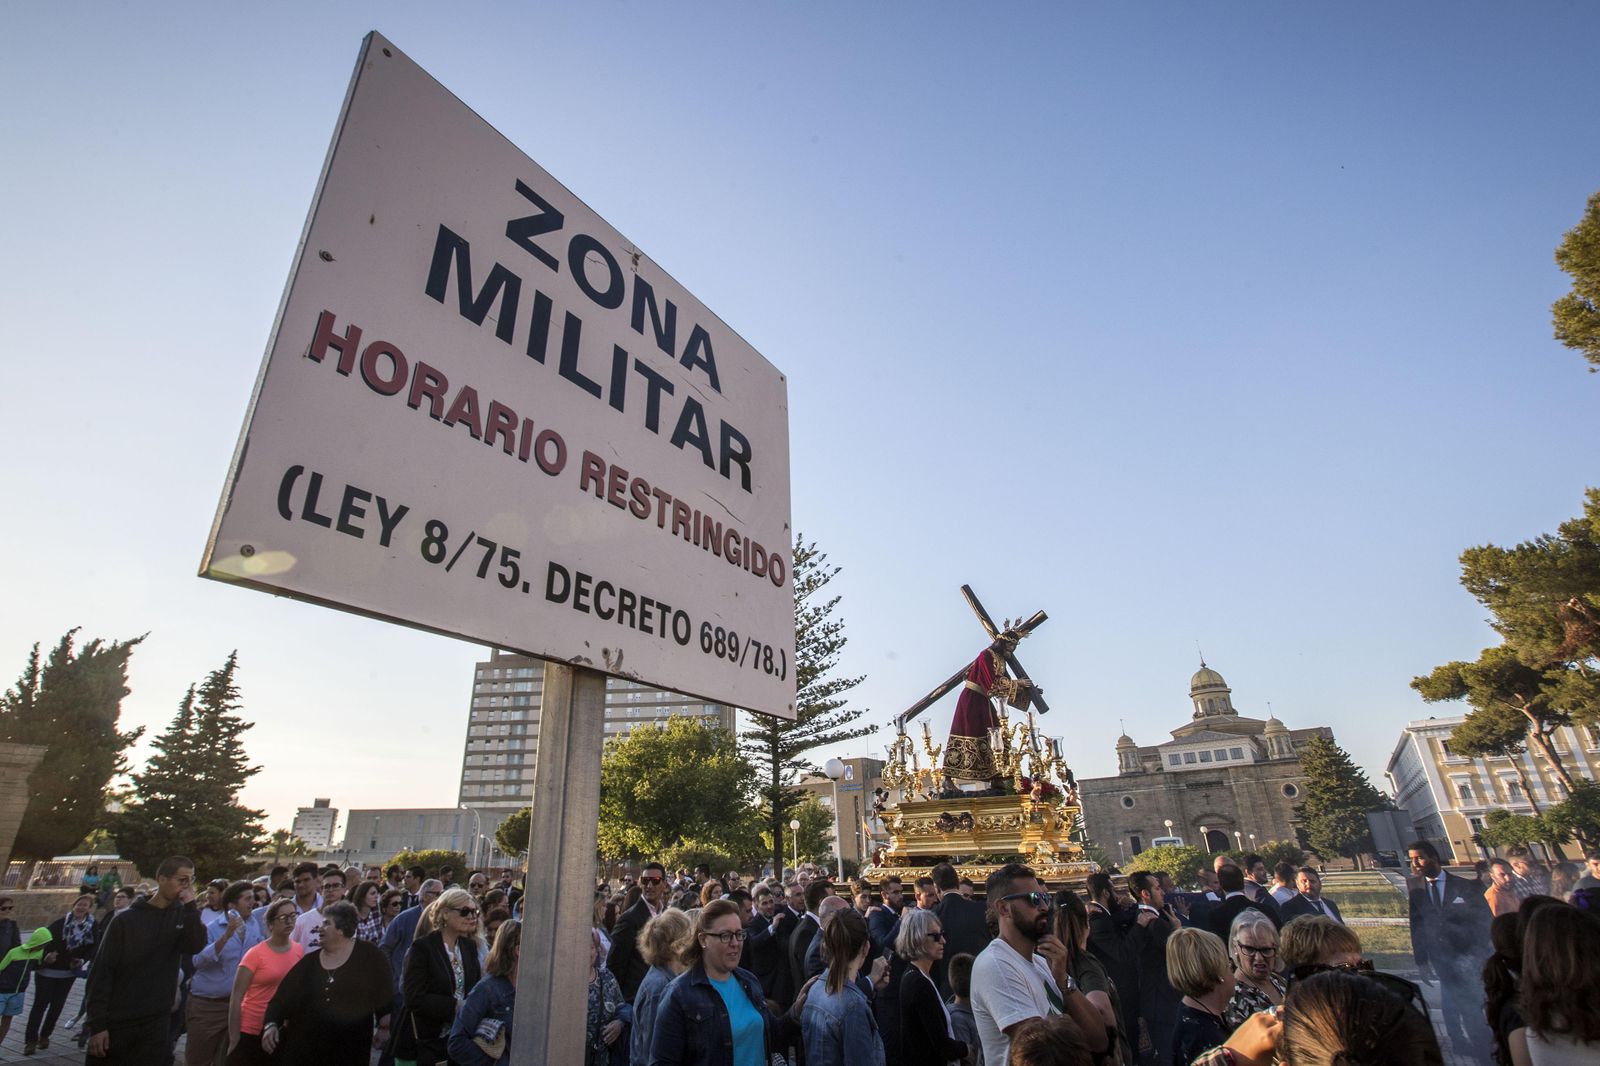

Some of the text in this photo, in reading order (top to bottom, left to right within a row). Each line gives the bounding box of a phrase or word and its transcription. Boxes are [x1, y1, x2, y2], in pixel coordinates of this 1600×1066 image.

[425, 224, 754, 494] MILITAR
[506, 179, 722, 394] ZONA
[308, 310, 786, 587] HORARIO RESTRINGIDO
[277, 464, 786, 682] (LEY 8/75. DECRETO 689/78.)
